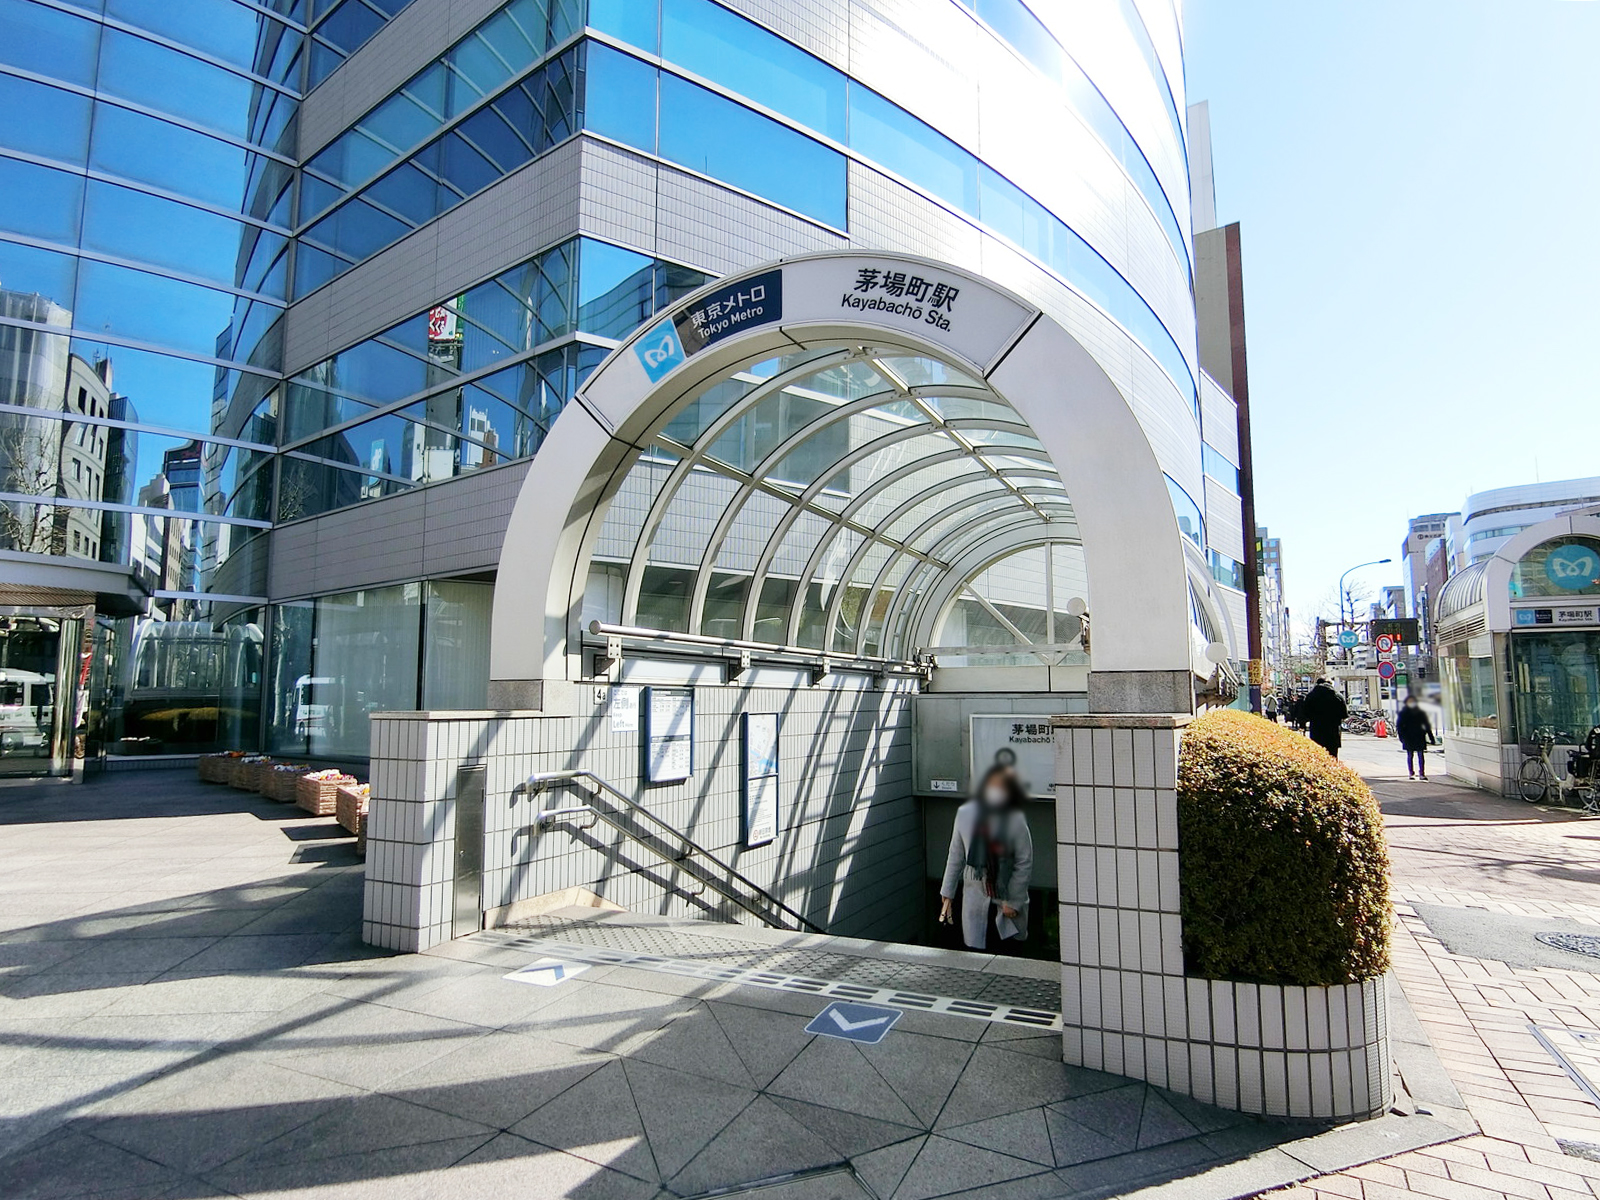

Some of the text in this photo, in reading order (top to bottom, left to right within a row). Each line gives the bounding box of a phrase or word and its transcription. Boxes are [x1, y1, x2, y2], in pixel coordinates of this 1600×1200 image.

[690, 284, 766, 329] 東京メトロ
[854, 268, 960, 313] 茅場町駅
[697, 306, 764, 339] Tokyo Metro
[841, 293, 951, 333] Kayabachō Sta.
[596, 689, 606, 701] 4a
[612, 719, 625, 729] Left
